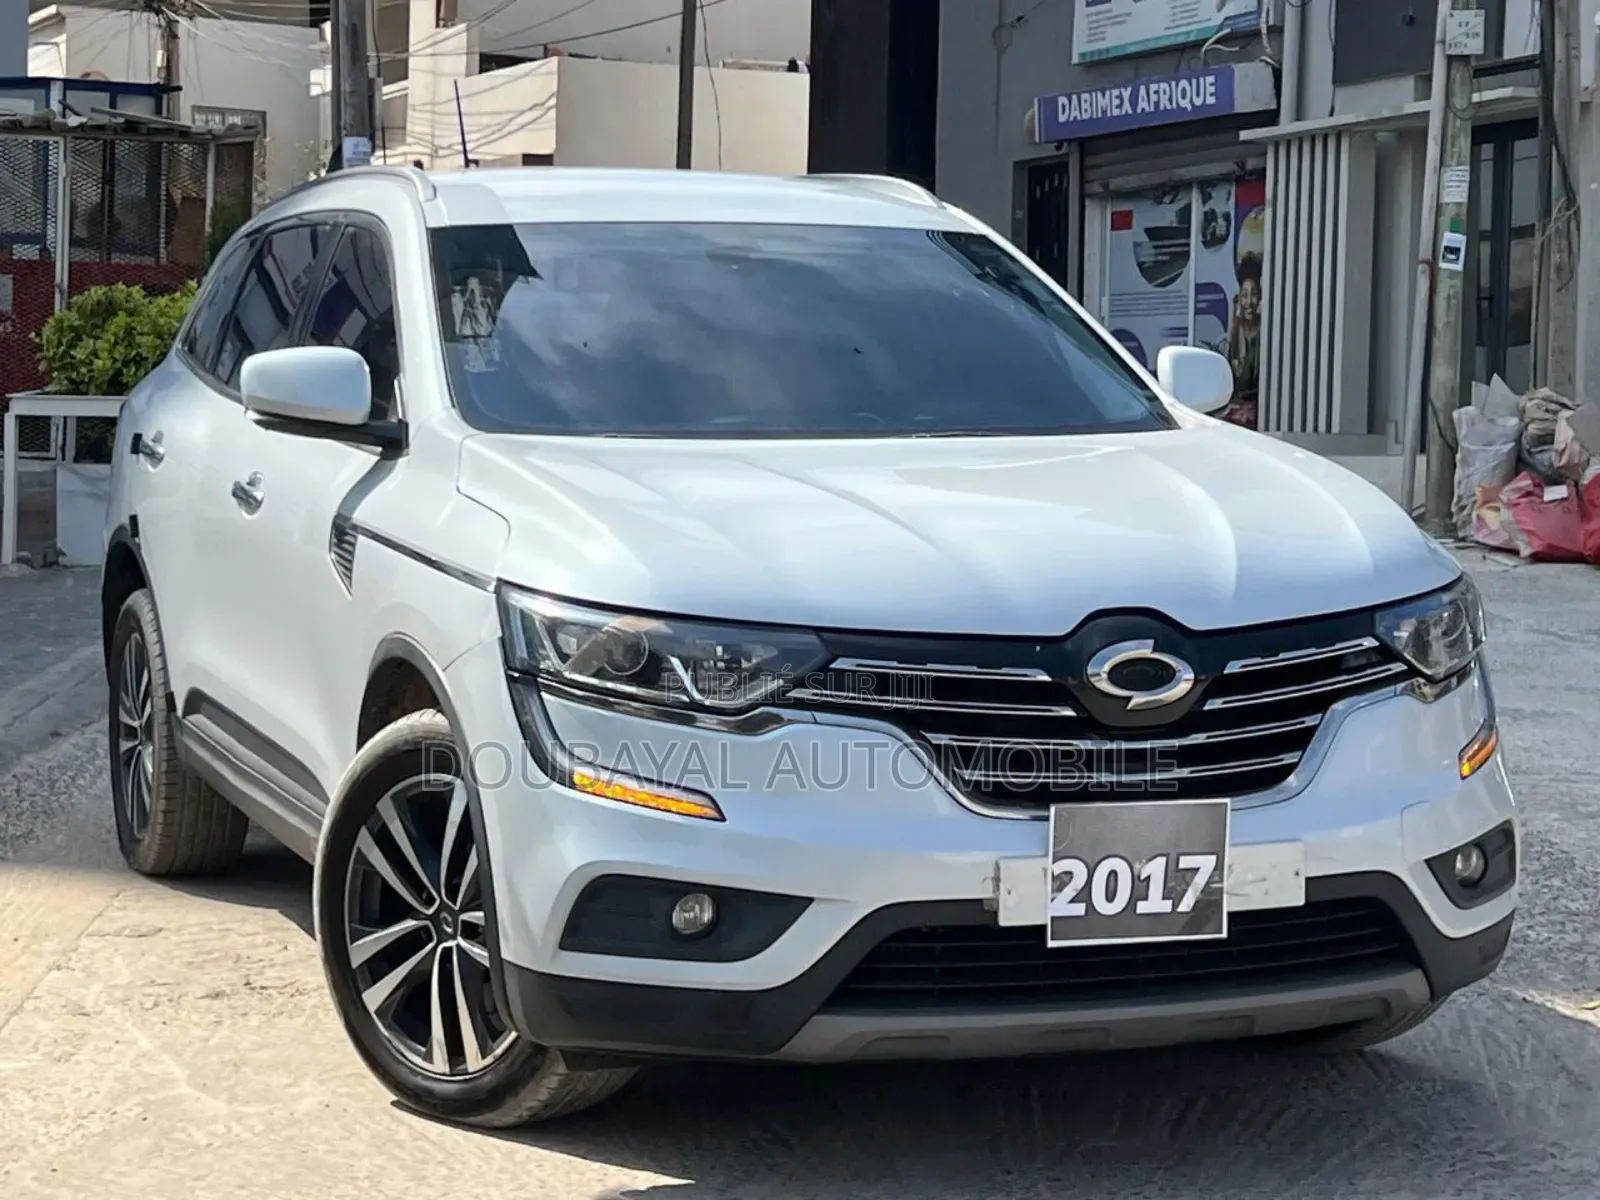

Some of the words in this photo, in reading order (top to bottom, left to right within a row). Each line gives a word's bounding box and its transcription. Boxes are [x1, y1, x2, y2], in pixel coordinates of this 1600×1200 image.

[1057, 87, 1133, 123] DABIMEX
[1136, 75, 1216, 112] AFRIQUE
[1050, 854, 1217, 917] 2017
